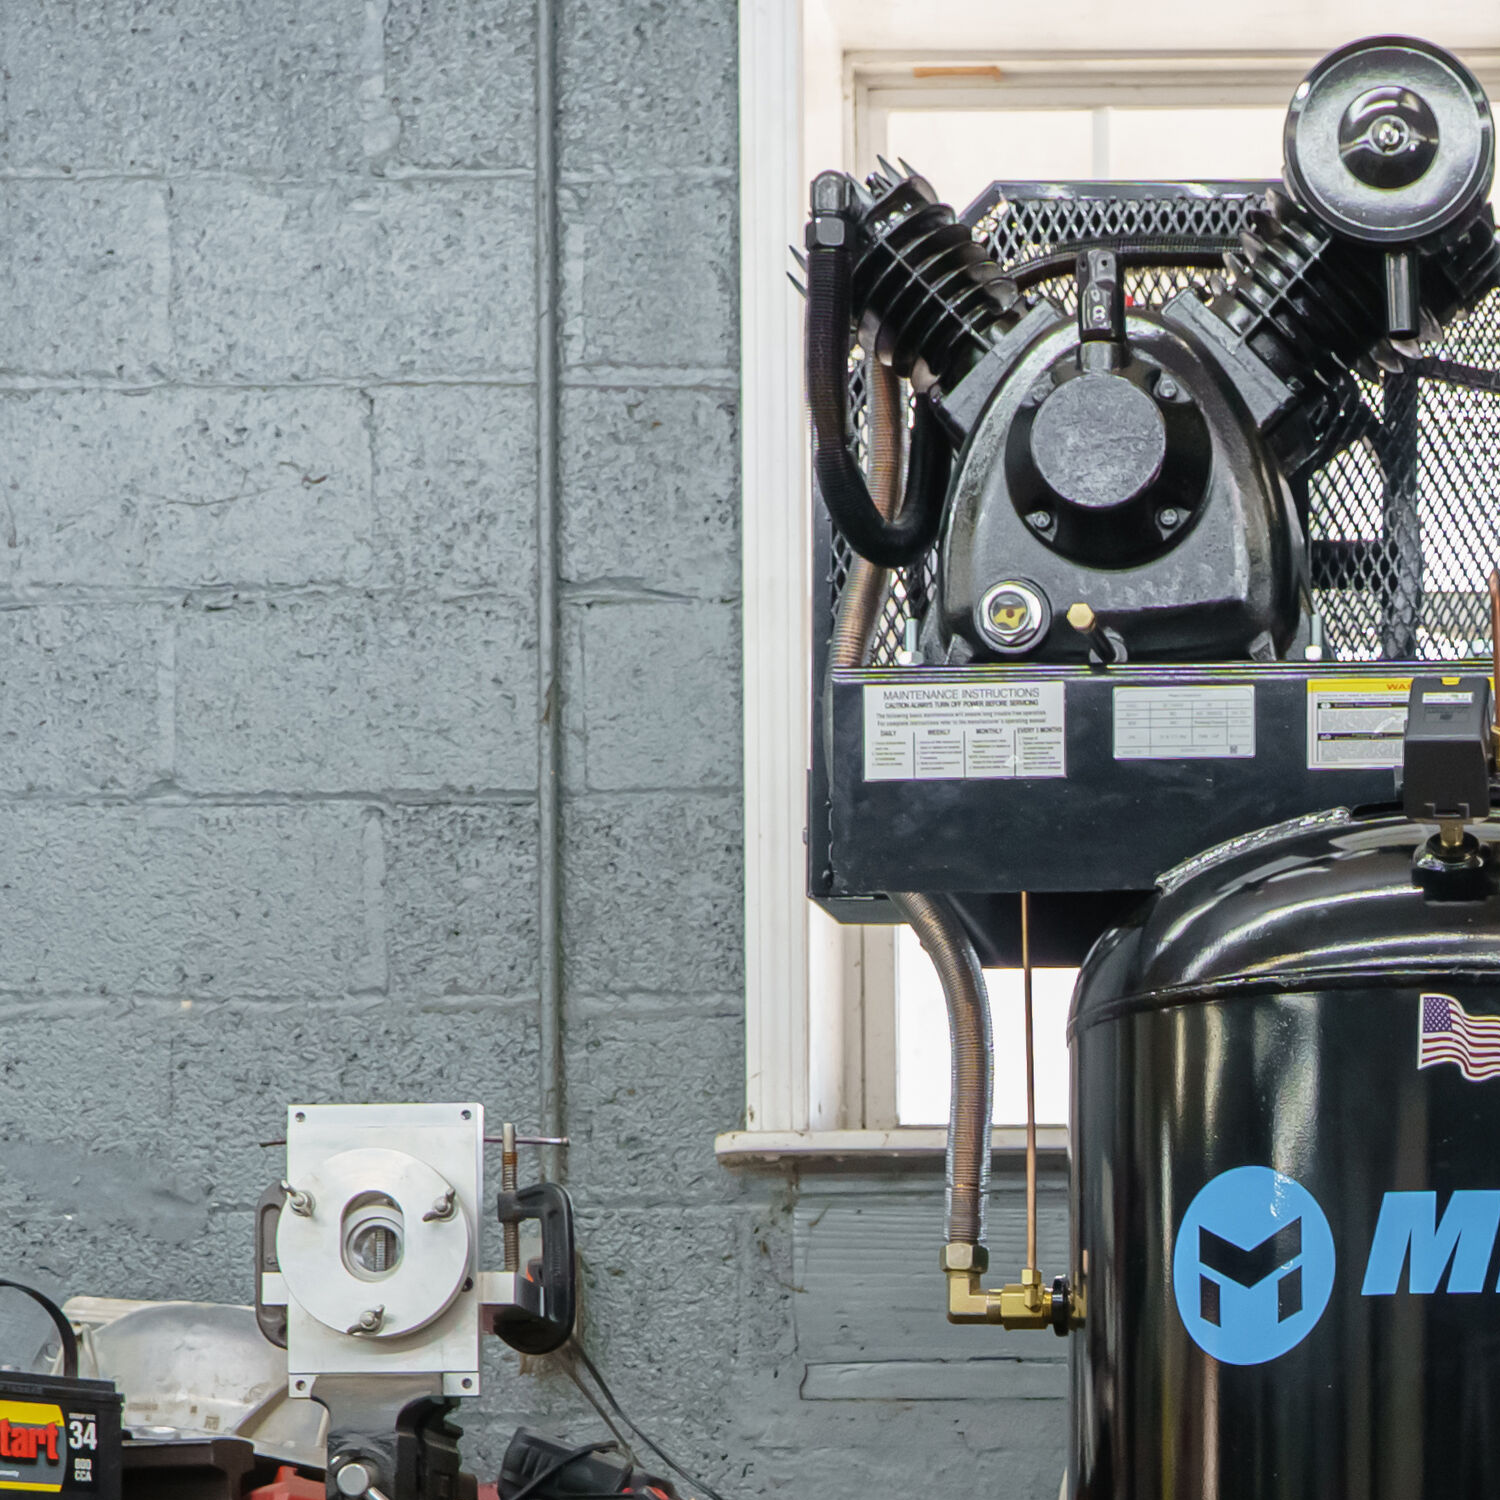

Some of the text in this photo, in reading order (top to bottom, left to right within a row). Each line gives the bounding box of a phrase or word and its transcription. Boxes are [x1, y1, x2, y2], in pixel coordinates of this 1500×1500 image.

[883, 687, 1040, 700] MAINTENANCE INSTRUCTIONS
[68, 1421, 97, 1450] 34
